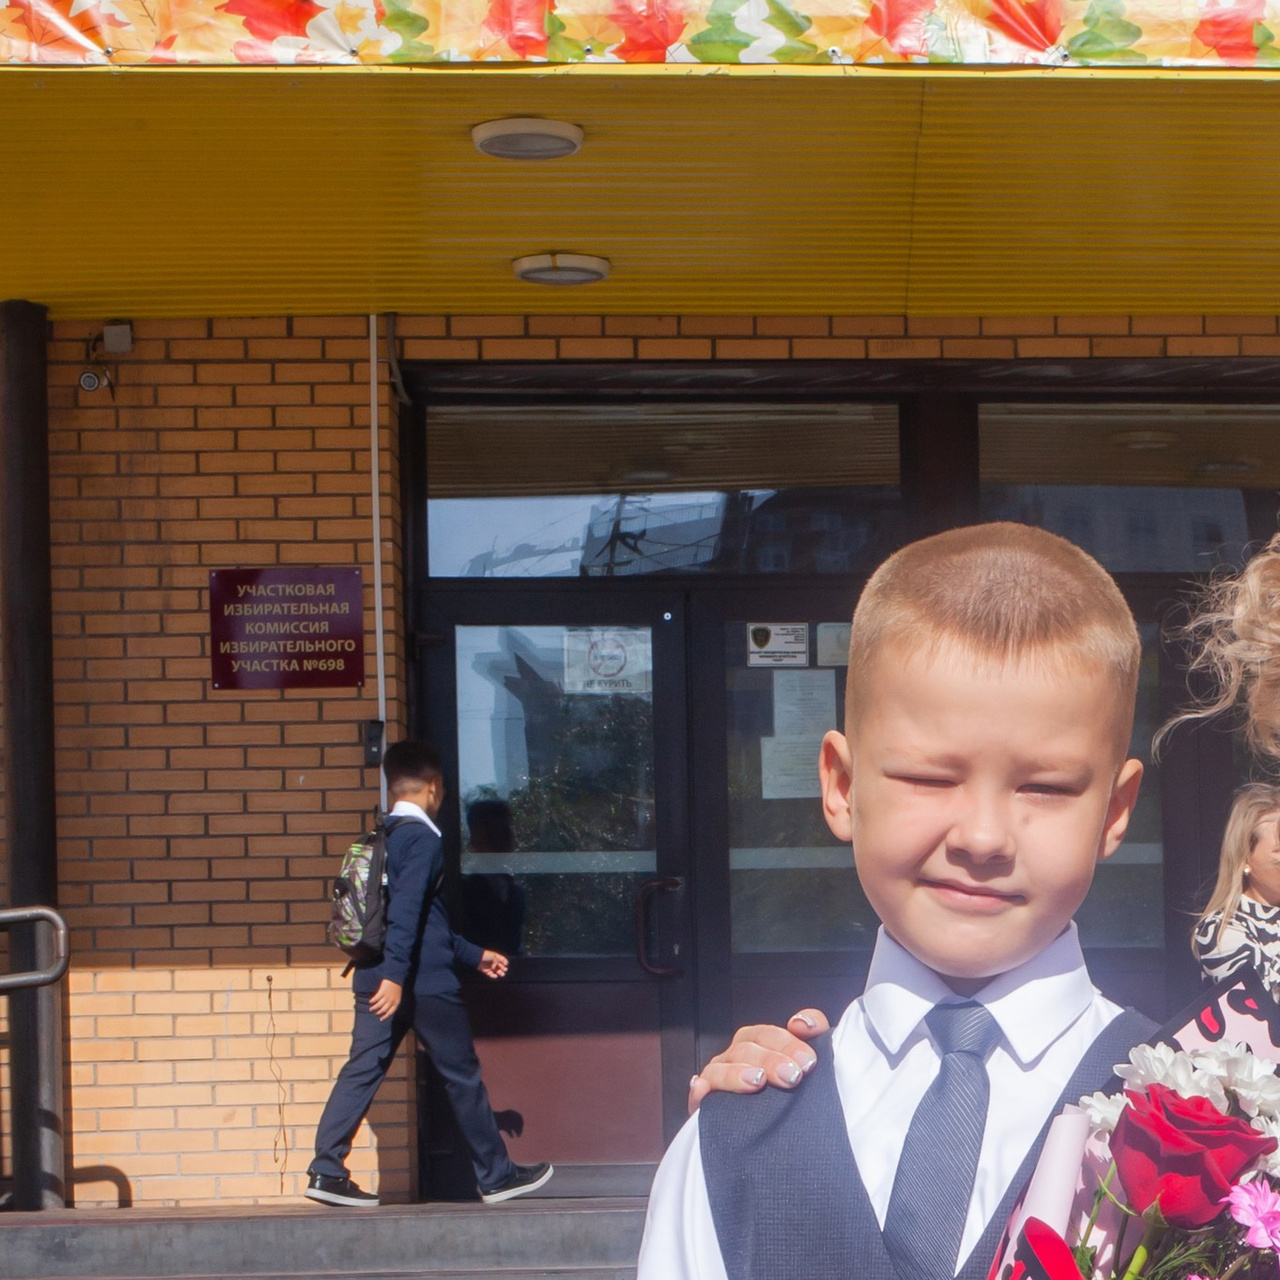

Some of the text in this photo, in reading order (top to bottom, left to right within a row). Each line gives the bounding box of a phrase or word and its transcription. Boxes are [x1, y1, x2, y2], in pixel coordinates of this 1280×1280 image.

[237, 584, 335, 597] УЧАСТКОВАЯ
[224, 602, 349, 616] ИЗБИРАТЕЛЬНАЯ
[245, 621, 329, 634] КОМИССИЯ
[220, 639, 355, 653] ИЗБИРАТЕЛЬНОГО
[231, 659, 345, 672] УЧАСТКА №698
[583, 679, 632, 688] НЕ КУРИТЬ
